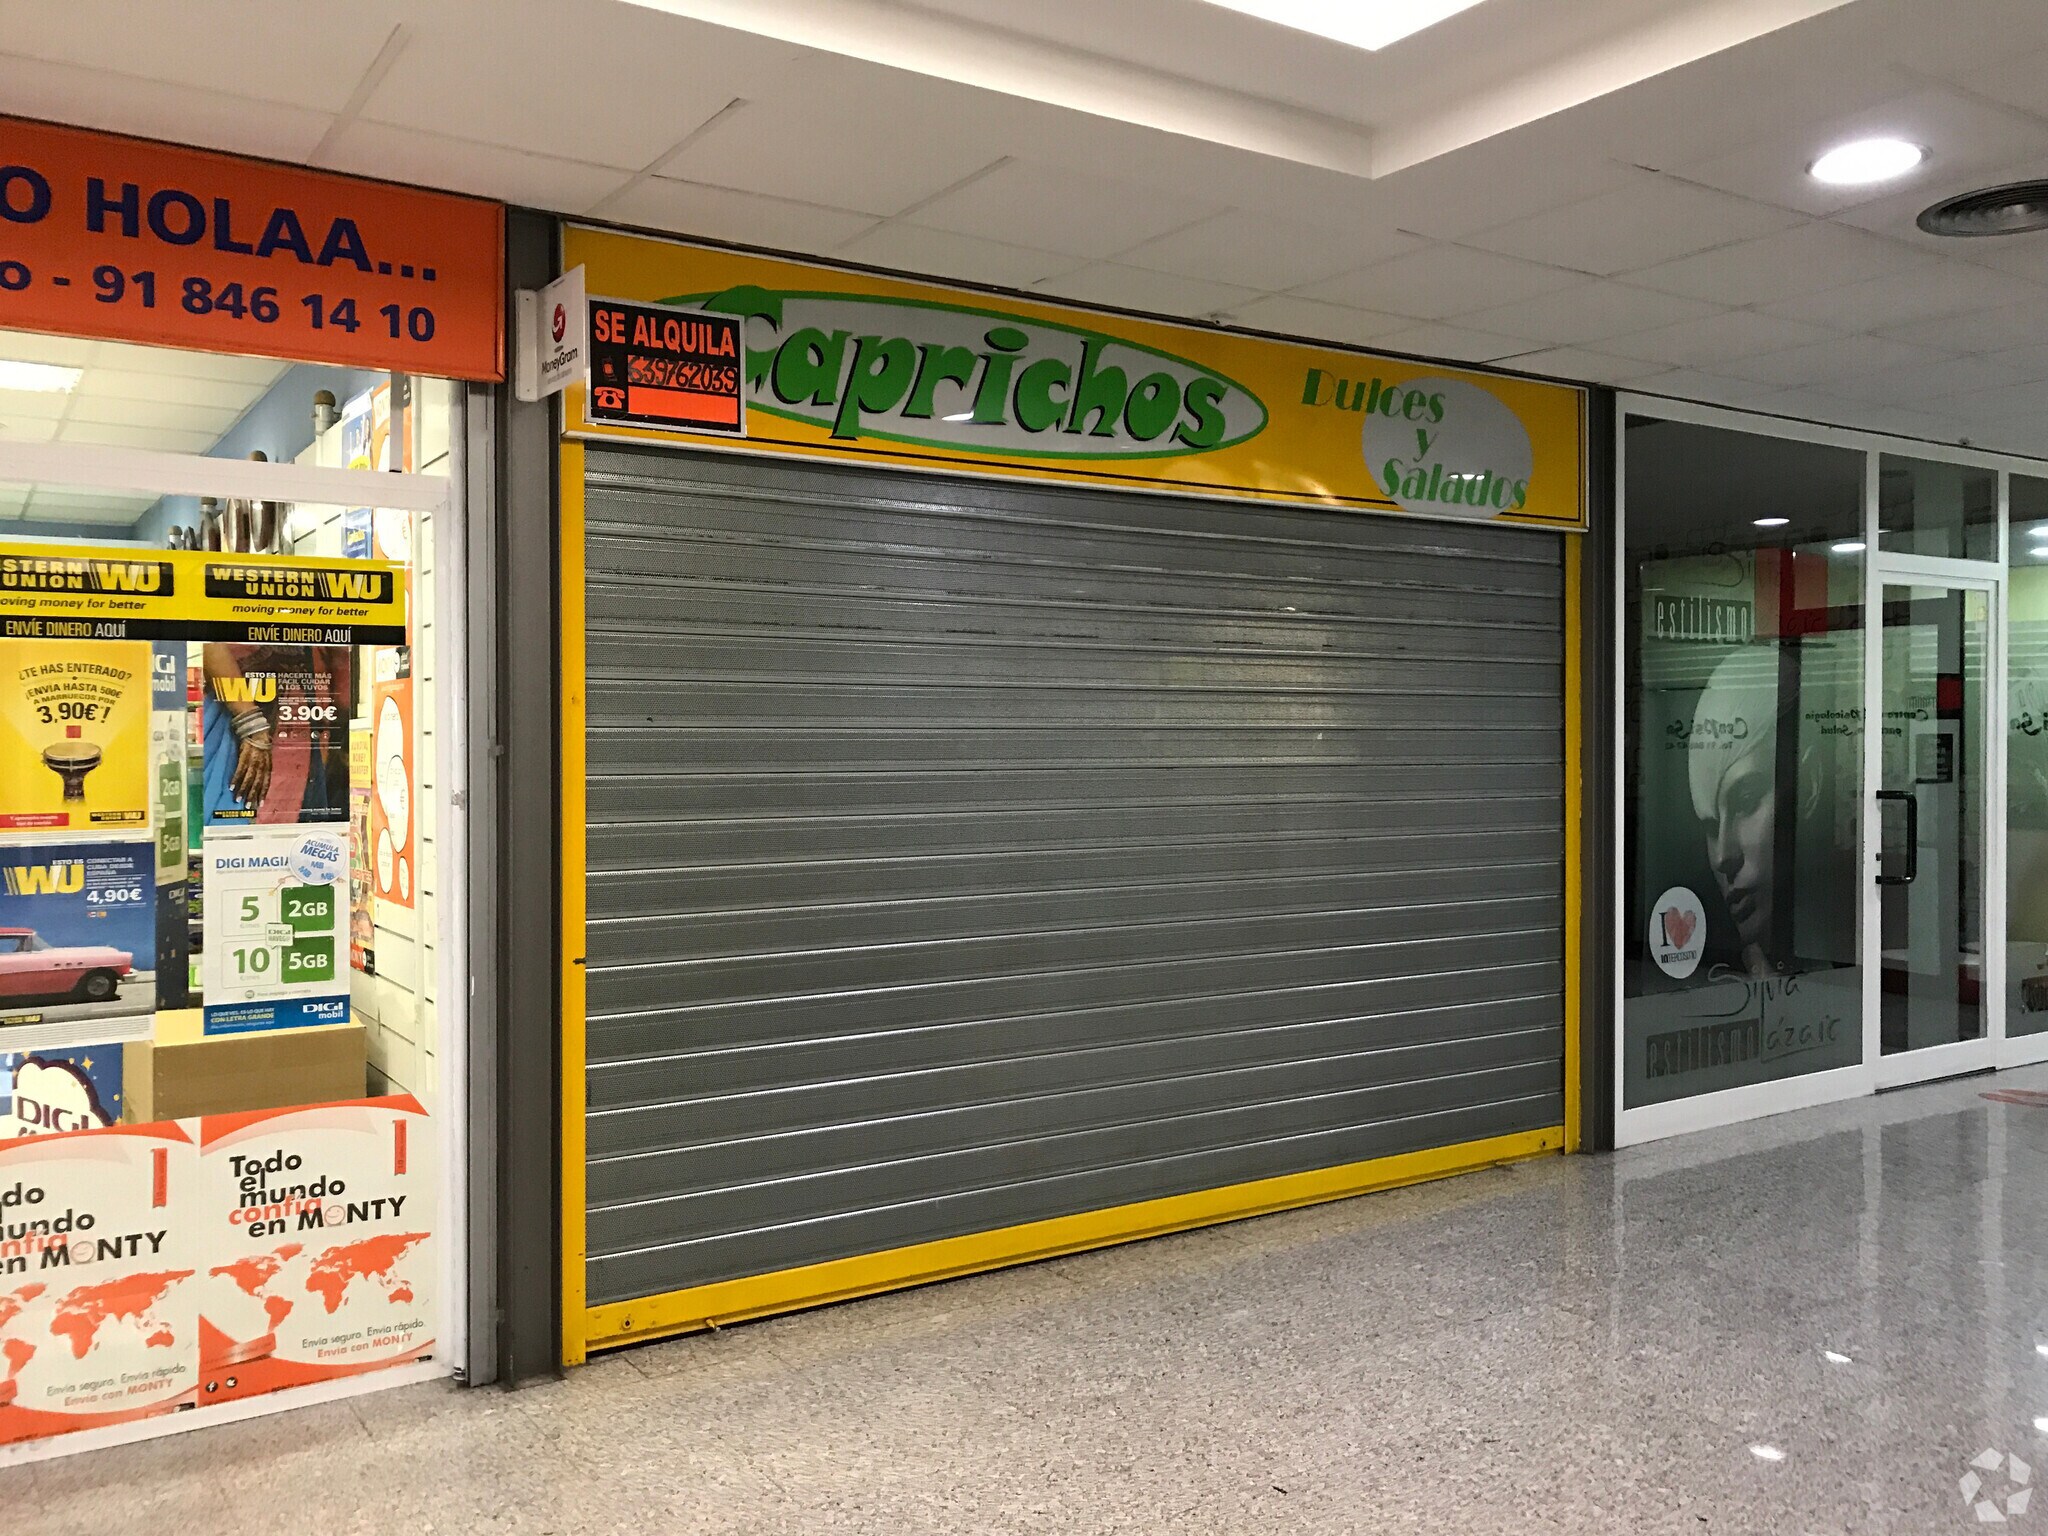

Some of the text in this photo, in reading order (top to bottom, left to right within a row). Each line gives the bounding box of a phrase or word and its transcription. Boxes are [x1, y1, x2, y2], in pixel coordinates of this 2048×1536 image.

[86, 177, 437, 282] HOLAA...
[92, 265, 155, 308] 91
[182, 277, 280, 323] 846
[302, 294, 360, 333] 14
[380, 304, 435, 342] 10
[595, 309, 736, 358] SE ALQUILA
[541, 347, 578, 375] MoneyGram
[1301, 368, 1447, 424] Dulces
[1412, 428, 1439, 462] y
[1380, 458, 1528, 510] Salados
[0, 558, 83, 574] STERN
[2, 573, 83, 589] UNION
[212, 567, 382, 600] WESTERN WU
[245, 583, 315, 598] UNION
[39, 598, 83, 610] money
[87, 598, 105, 609] for
[108, 599, 147, 610] better
[232, 604, 369, 617] moving money for better
[1657, 594, 1748, 641] estilismo
[6, 618, 126, 638] ENVÍE DINERO AQUÍ
[248, 624, 351, 643] ENVÍE DINERO AQUÍ
[18, 662, 133, 681] ¿TE HAS ENTERADO?
[63, 682, 97, 693] HASTA
[220, 677, 277, 703] WU
[278, 705, 338, 721] 3.90€
[300, 844, 340, 863] MEGAS
[305, 839, 340, 853] ACUMULA
[216, 858, 245, 869] DIGI
[86, 888, 143, 904] 4,90€
[240, 896, 260, 921] 5
[288, 899, 328, 918] 2GB
[233, 947, 270, 974] 10
[288, 952, 328, 970] 5GB
[303, 1002, 343, 1013] DIGI
[318, 1011, 343, 1019] mobil
[229, 1149, 302, 1178] Todo
[239, 1166, 266, 1192] el
[239, 1175, 346, 1208] mundo
[248, 1217, 286, 1238] en
[351, 1342, 369, 1352] con
[372, 1331, 413, 1348] MONTY
[101, 1389, 123, 1400] con
[126, 1377, 174, 1396] MONTY
